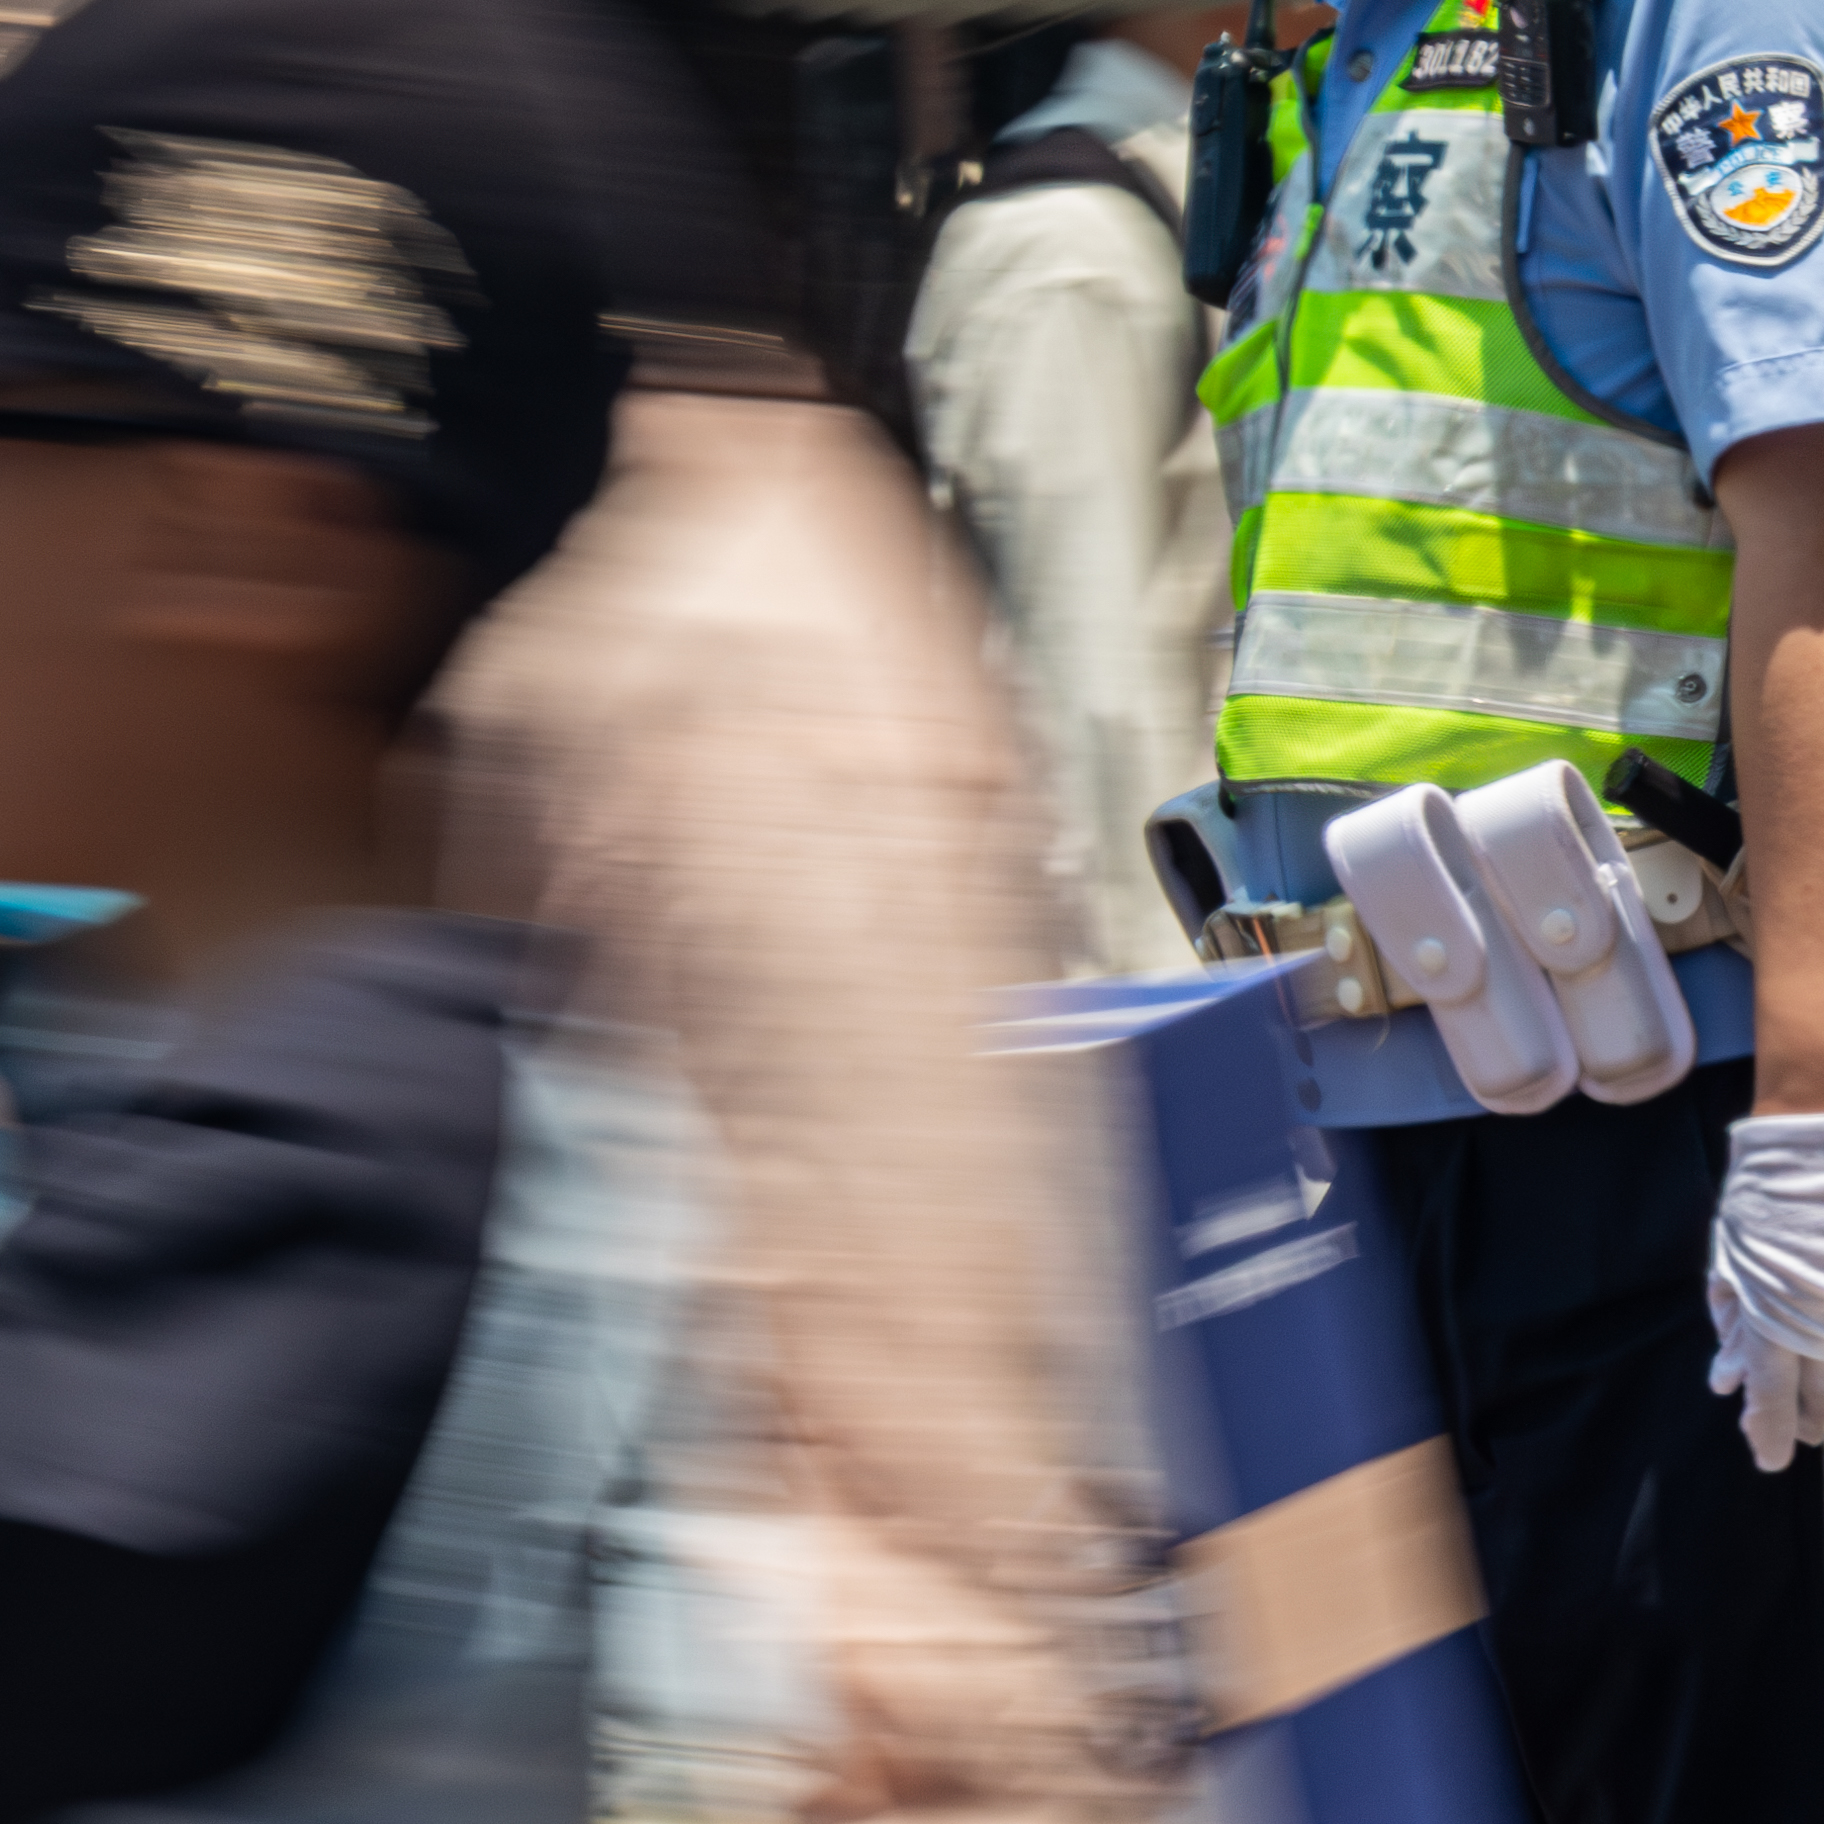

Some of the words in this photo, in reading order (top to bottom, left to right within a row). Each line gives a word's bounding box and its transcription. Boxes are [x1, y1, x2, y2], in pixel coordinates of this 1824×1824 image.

[1661, 67, 1811, 135] 中华人民共和国
